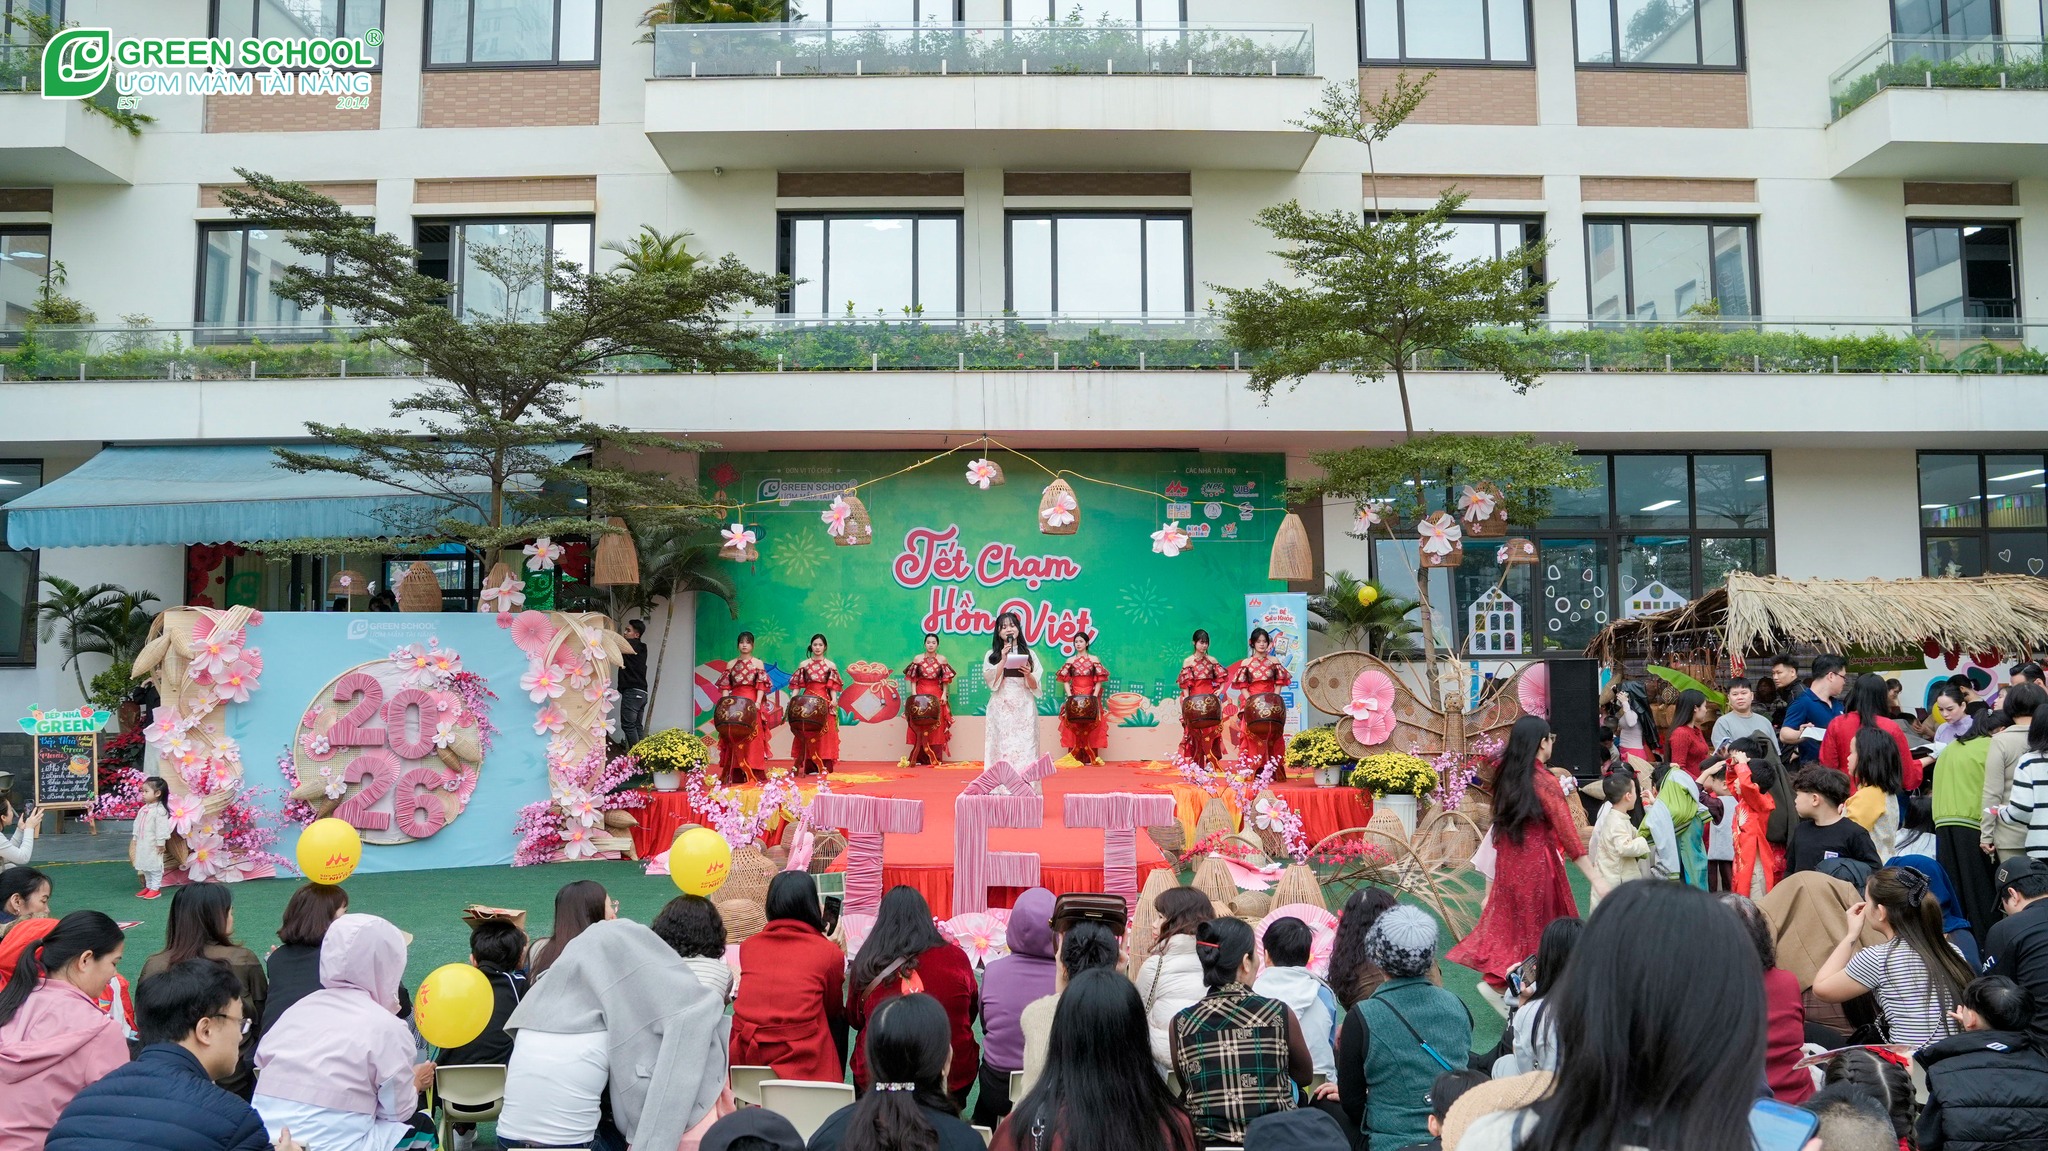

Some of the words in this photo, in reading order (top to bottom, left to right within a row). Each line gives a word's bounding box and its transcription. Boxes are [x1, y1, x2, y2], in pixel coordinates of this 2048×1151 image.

[781, 483, 814, 491] GREEN
[1233, 485, 1250, 493] VIB
[893, 524, 973, 587] Tết
[976, 542, 1081, 589] Chạm
[370, 622, 400, 630] GREEN
[401, 622, 437, 630] SCHOOL
[922, 585, 998, 634] Hồn
[998, 599, 1099, 656] Việt
[36, 719, 94, 733] GREEN
